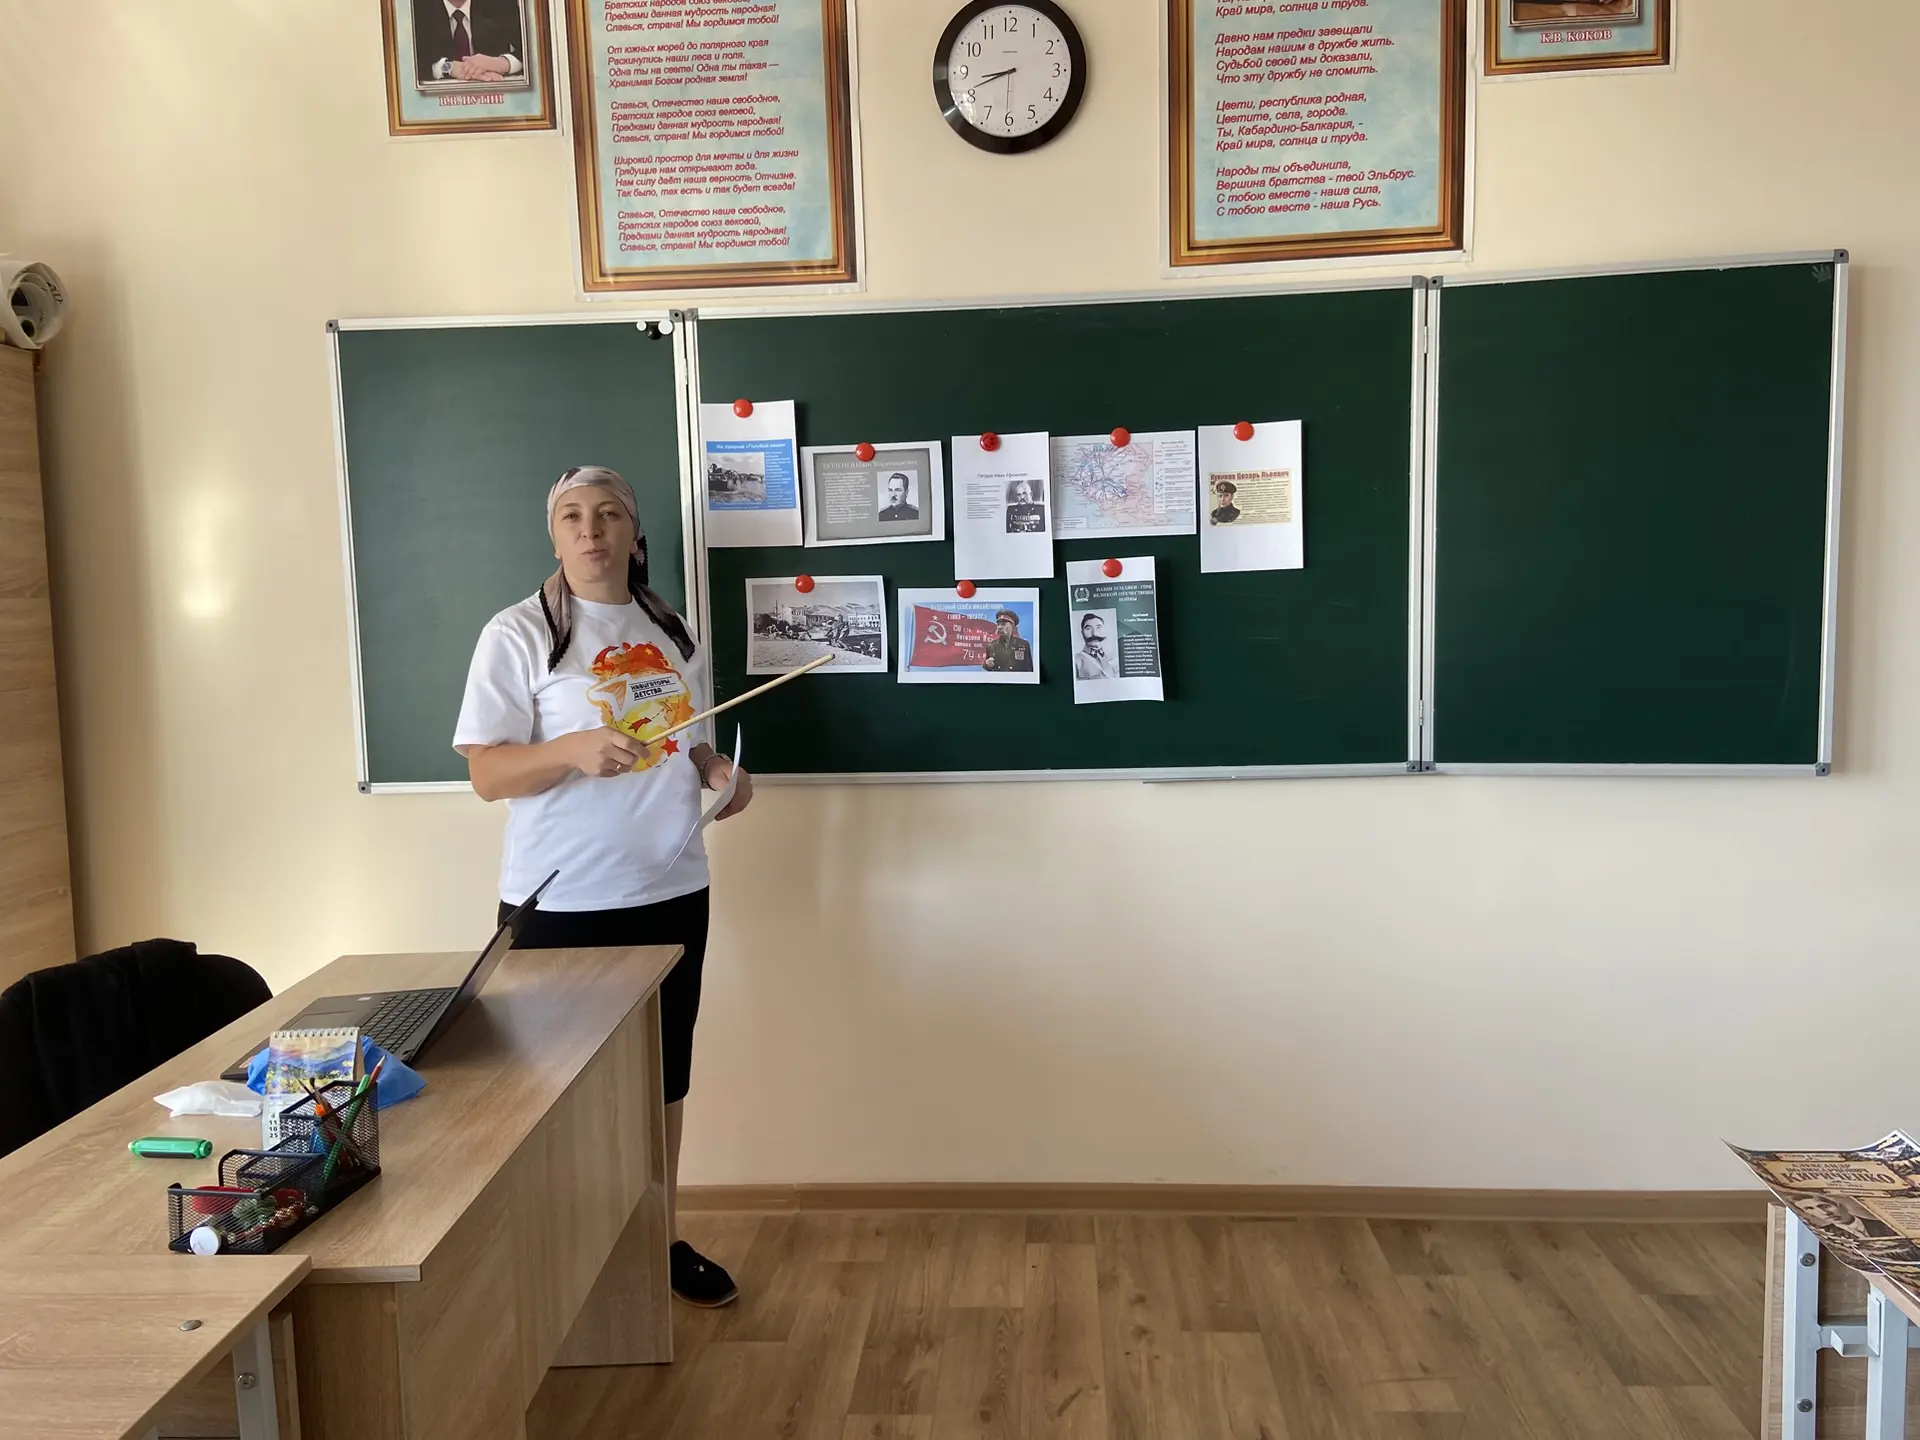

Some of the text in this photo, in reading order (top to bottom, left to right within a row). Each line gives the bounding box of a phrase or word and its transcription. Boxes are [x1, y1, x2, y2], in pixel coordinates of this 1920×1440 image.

[1215, 5, 1242, 18] Край
[1245, 5, 1275, 15] мира,
[1279, 2, 1318, 12] солнца
[1321, 1, 1328, 9] и
[984, 24, 994, 40] 11
[1004, 17, 1018, 32] 12
[1032, 23, 1036, 38] 1
[1214, 26, 1373, 45] Давно нам предки завещали
[1540, 30, 1611, 43] К.В. КОКОВ
[607, 39, 768, 54] От южных морей до полярного края
[967, 42, 982, 57] 10
[1045, 40, 1054, 55] 2
[1216, 45, 1265, 58] Народам
[1268, 43, 1305, 53] нашим
[1317, 38, 1358, 52] дружбе
[1360, 38, 1394, 47] жить.
[607, 56, 663, 66] Раскинулись
[691, 53, 712, 61] леса
[1216, 52, 1372, 72] Судьбой своей мы доказали,
[608, 67, 631, 76] Одна
[663, 64, 694, 74] свете!
[696, 63, 719, 72] Одна
[738, 62, 767, 70] такая
[960, 65, 969, 80] 9
[1052, 63, 1061, 78] 3
[1216, 65, 1378, 83] Что эту дружбу не сломить.
[608, 72, 747, 89] Хранимая Богом родная земля!
[967, 89, 976, 104] 8
[1043, 87, 1053, 102] 4
[1216, 92, 1366, 112] Цвети, республика родная,
[984, 105, 992, 120] 7
[1004, 111, 1014, 126] 6
[1027, 105, 1036, 120] 5
[1216, 106, 1347, 125] Цветите, села, города.
[1218, 121, 1354, 137] Ты, Кабардино-Балкария,
[1216, 139, 1243, 152] Край
[1245, 139, 1275, 150] мира,
[1279, 136, 1318, 146] солнца
[1330, 131, 1367, 144] труда.
[614, 155, 653, 166] Широкий
[654, 155, 693, 164] простор
[695, 153, 711, 161] для
[754, 150, 770, 158] для
[615, 166, 657, 177] Грядущие
[678, 164, 732, 174] открывают
[734, 162, 757, 170] года.
[1216, 161, 1351, 178] Народы ты объединила,
[615, 178, 634, 186] Нам
[635, 178, 656, 187] силу
[657, 176, 681, 185] даёт
[709, 175, 752, 184] верность
[754, 172, 796, 180] Отчизне.
[1216, 169, 1415, 191] Вершина братства твой Эльбрус.
[618, 189, 632, 197] Так
[633, 188, 658, 196] было,
[680, 187, 703, 195] есть
[732, 183, 760, 194] будет
[762, 181, 795, 191] всегда!
[1216, 185, 1380, 203] С тобою вместе наша сила,
[617, 210, 655, 219] Славься,
[658, 209, 710, 217] Отечество
[737, 205, 785, 214] свободное,
[1216, 197, 1380, 216] С тобою вместе наша Русь.
[618, 216, 761, 231] Братских народов союз вековой,
[618, 226, 786, 242] Предками данная мудрость народная!
[619, 236, 790, 251] Славься, страна! Мы гордимся тобой!
[630, 679, 671, 691] НАВИГАТОРЫ
[634, 687, 662, 699] ДЕТСТВА
[1783, 1173, 1895, 1184] КИРИЧЕНКО
